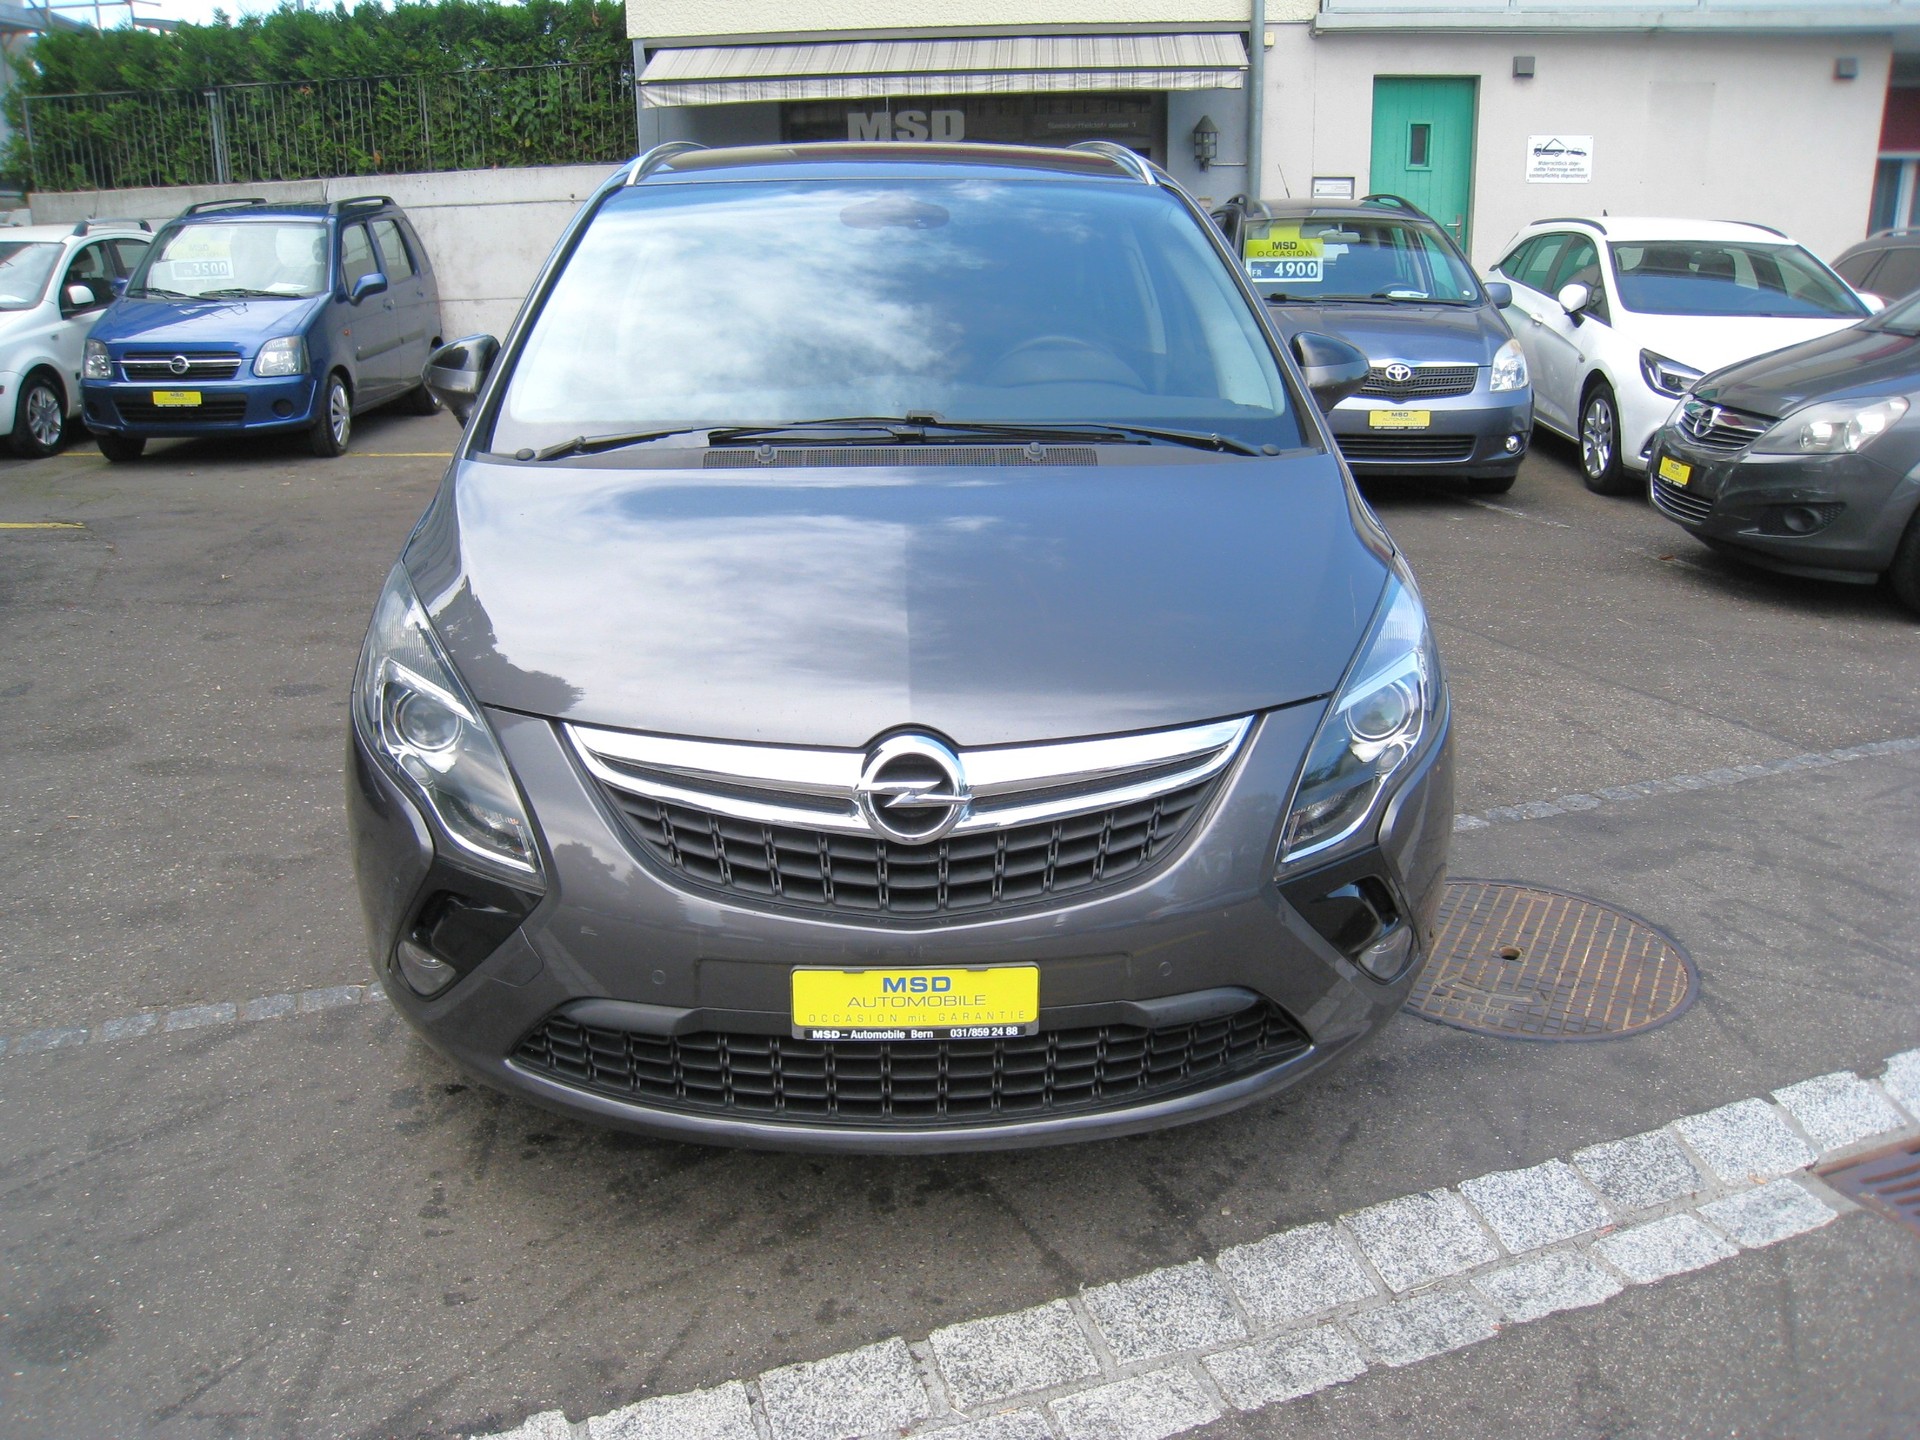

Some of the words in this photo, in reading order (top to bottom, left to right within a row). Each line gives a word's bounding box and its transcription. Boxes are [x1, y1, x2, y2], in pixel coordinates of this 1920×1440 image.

[847, 110, 965, 142] MSD
[1272, 241, 1298, 250] MSD
[1256, 250, 1313, 258] OCCASION
[192, 262, 227, 276] 3500
[1252, 269, 1262, 277] FR
[1273, 262, 1318, 277] 4900
[883, 976, 951, 993] MSD
[847, 994, 986, 1008] AUTOMOBILE
[808, 1013, 898, 1024] OCCASION
[908, 1013, 926, 1023] mit
[938, 1009, 1025, 1022] GARANTIE
[851, 1029, 906, 1040] Automobile
[911, 1029, 934, 1039] Bern
[949, 1027, 989, 1039] 031/859
[991, 1027, 1004, 1037] 24
[1005, 1026, 1018, 1036] 88
